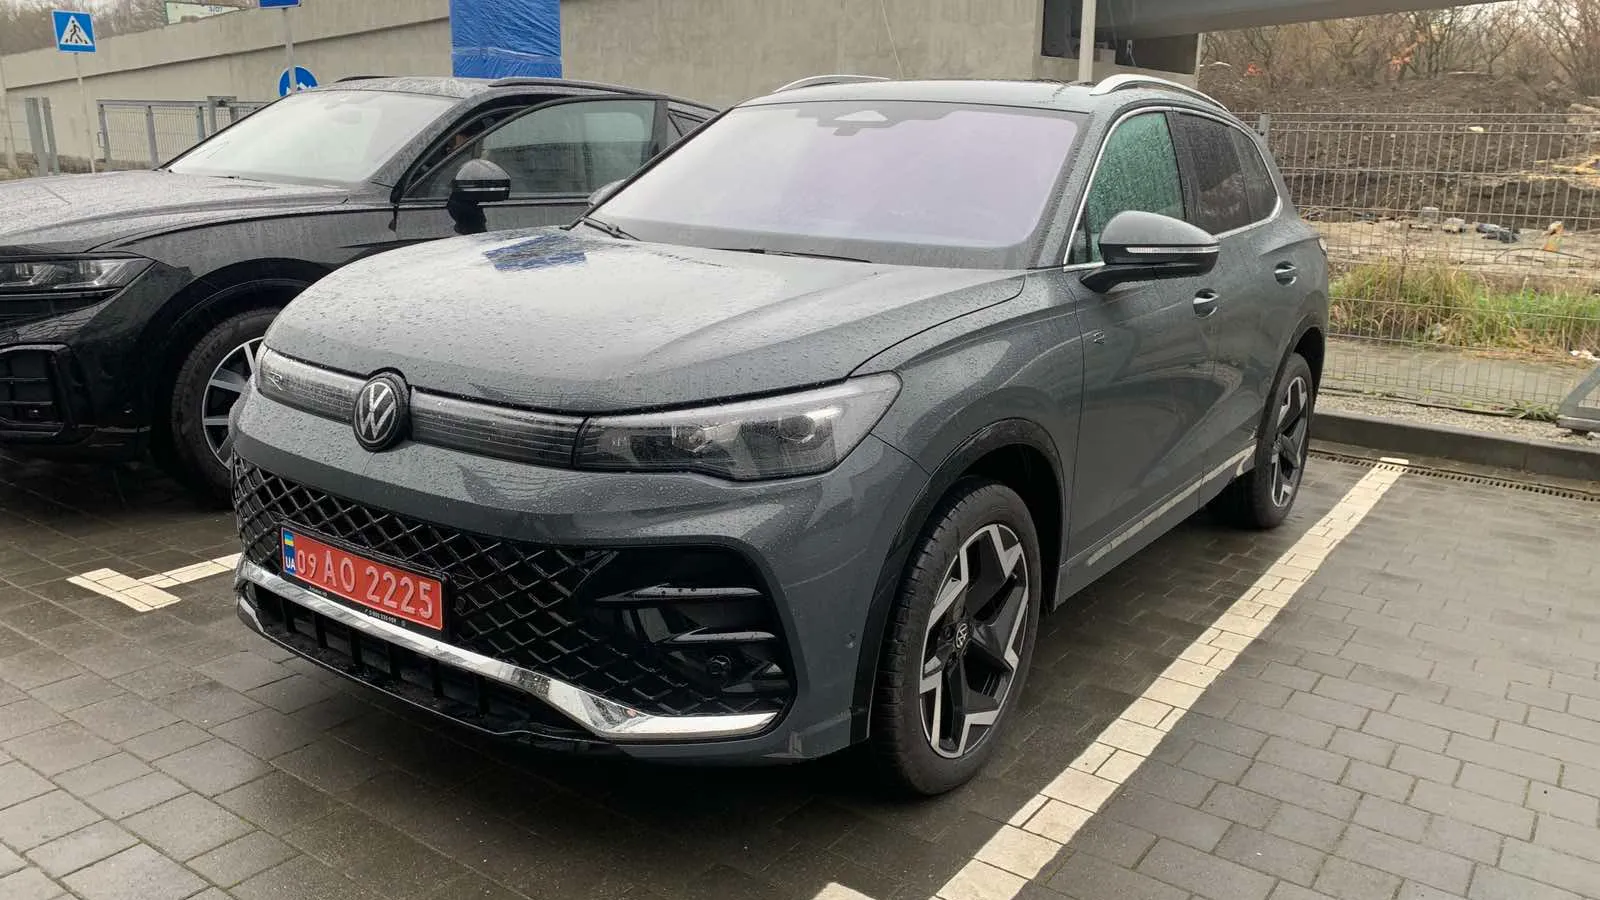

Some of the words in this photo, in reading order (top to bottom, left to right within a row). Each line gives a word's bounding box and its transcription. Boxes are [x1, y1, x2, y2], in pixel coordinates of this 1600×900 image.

[356, 382, 397, 443] VW
[285, 555, 296, 570] UA
[297, 550, 317, 578] 09
[323, 550, 356, 593] AO
[365, 565, 433, 620] 2225
